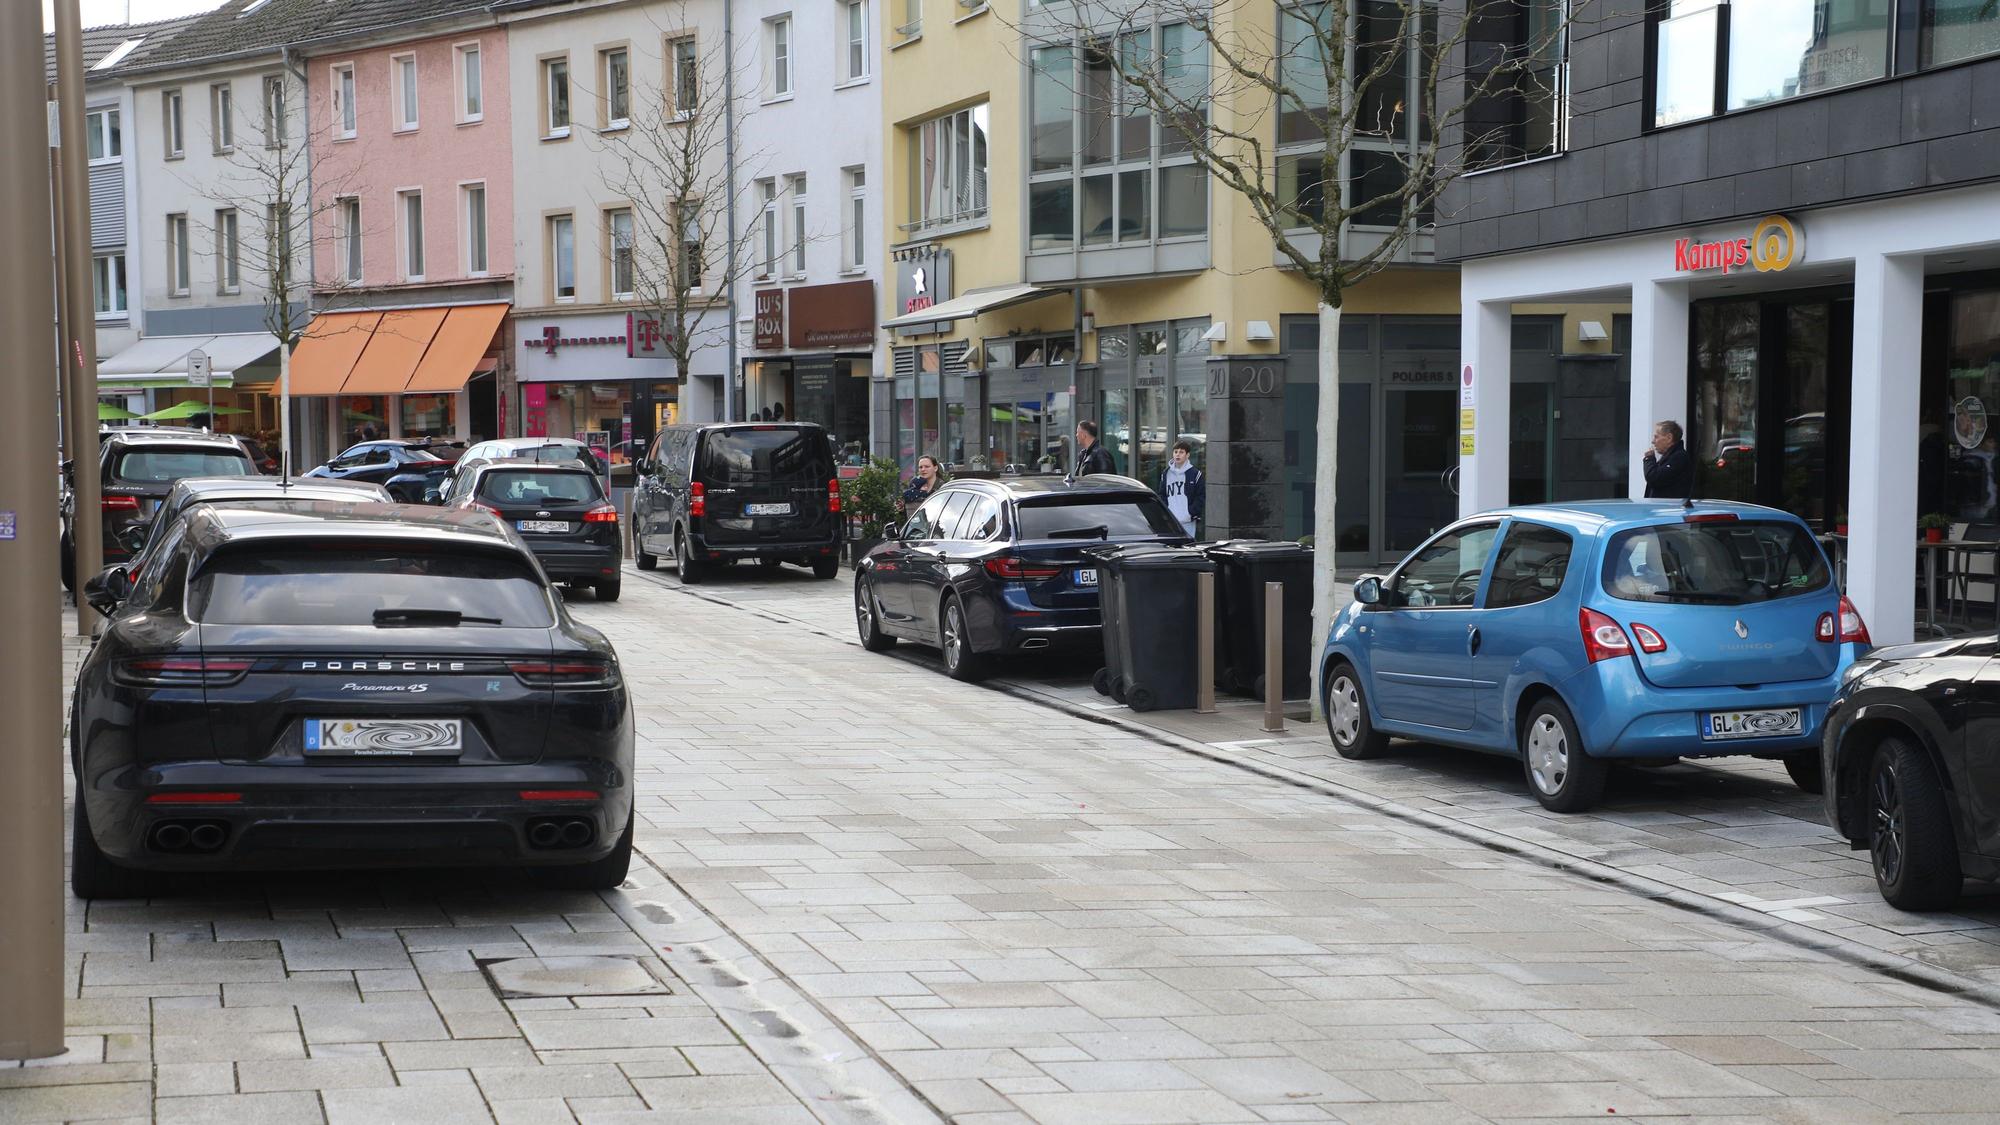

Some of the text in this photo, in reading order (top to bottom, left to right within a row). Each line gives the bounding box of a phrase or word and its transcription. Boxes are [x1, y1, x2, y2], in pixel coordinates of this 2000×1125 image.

[1675, 238, 1748, 275] Kamps
[757, 294, 781, 314] LU'S
[757, 317, 781, 336] BOX
[1209, 367, 1226, 396] 20
[1240, 366, 1275, 395] 20
[1392, 371, 1444, 382] POLDERS
[1081, 571, 1097, 583] GL
[302, 661, 465, 670] PORSCHE
[341, 683, 429, 693] Panamera 4S
[1713, 715, 1732, 733] GL
[322, 722, 338, 746] K
